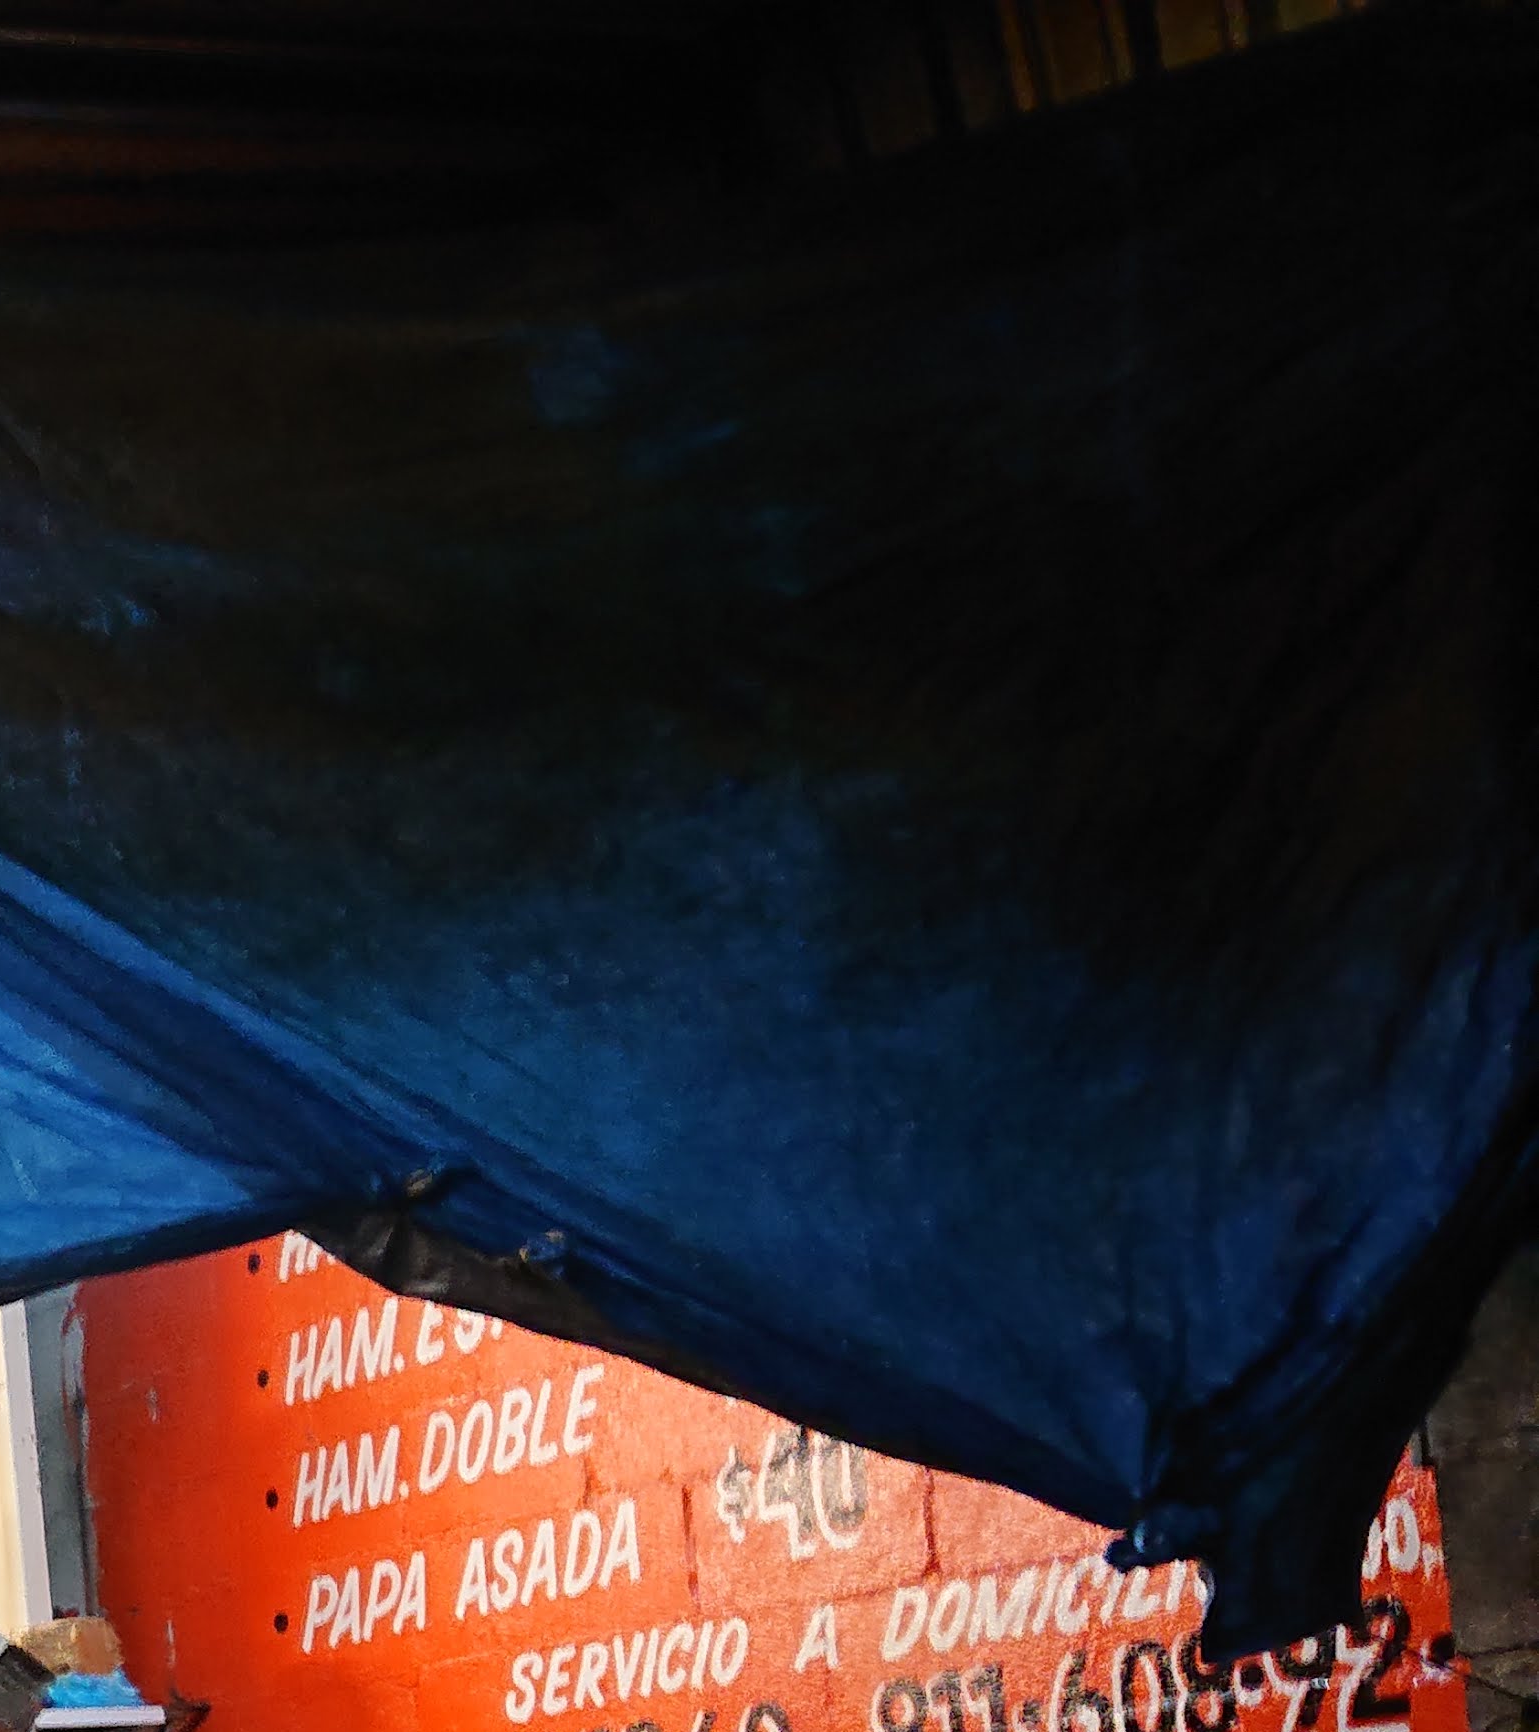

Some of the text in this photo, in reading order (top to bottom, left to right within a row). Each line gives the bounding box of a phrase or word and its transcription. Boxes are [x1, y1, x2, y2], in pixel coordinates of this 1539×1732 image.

[301, 1426, 867, 1655] PAPA ASADA $40
[505, 1616, 750, 1724] SERVICIO
[792, 1603, 841, 1673] A
[880, 1554, 1212, 1662] DOMICILI
